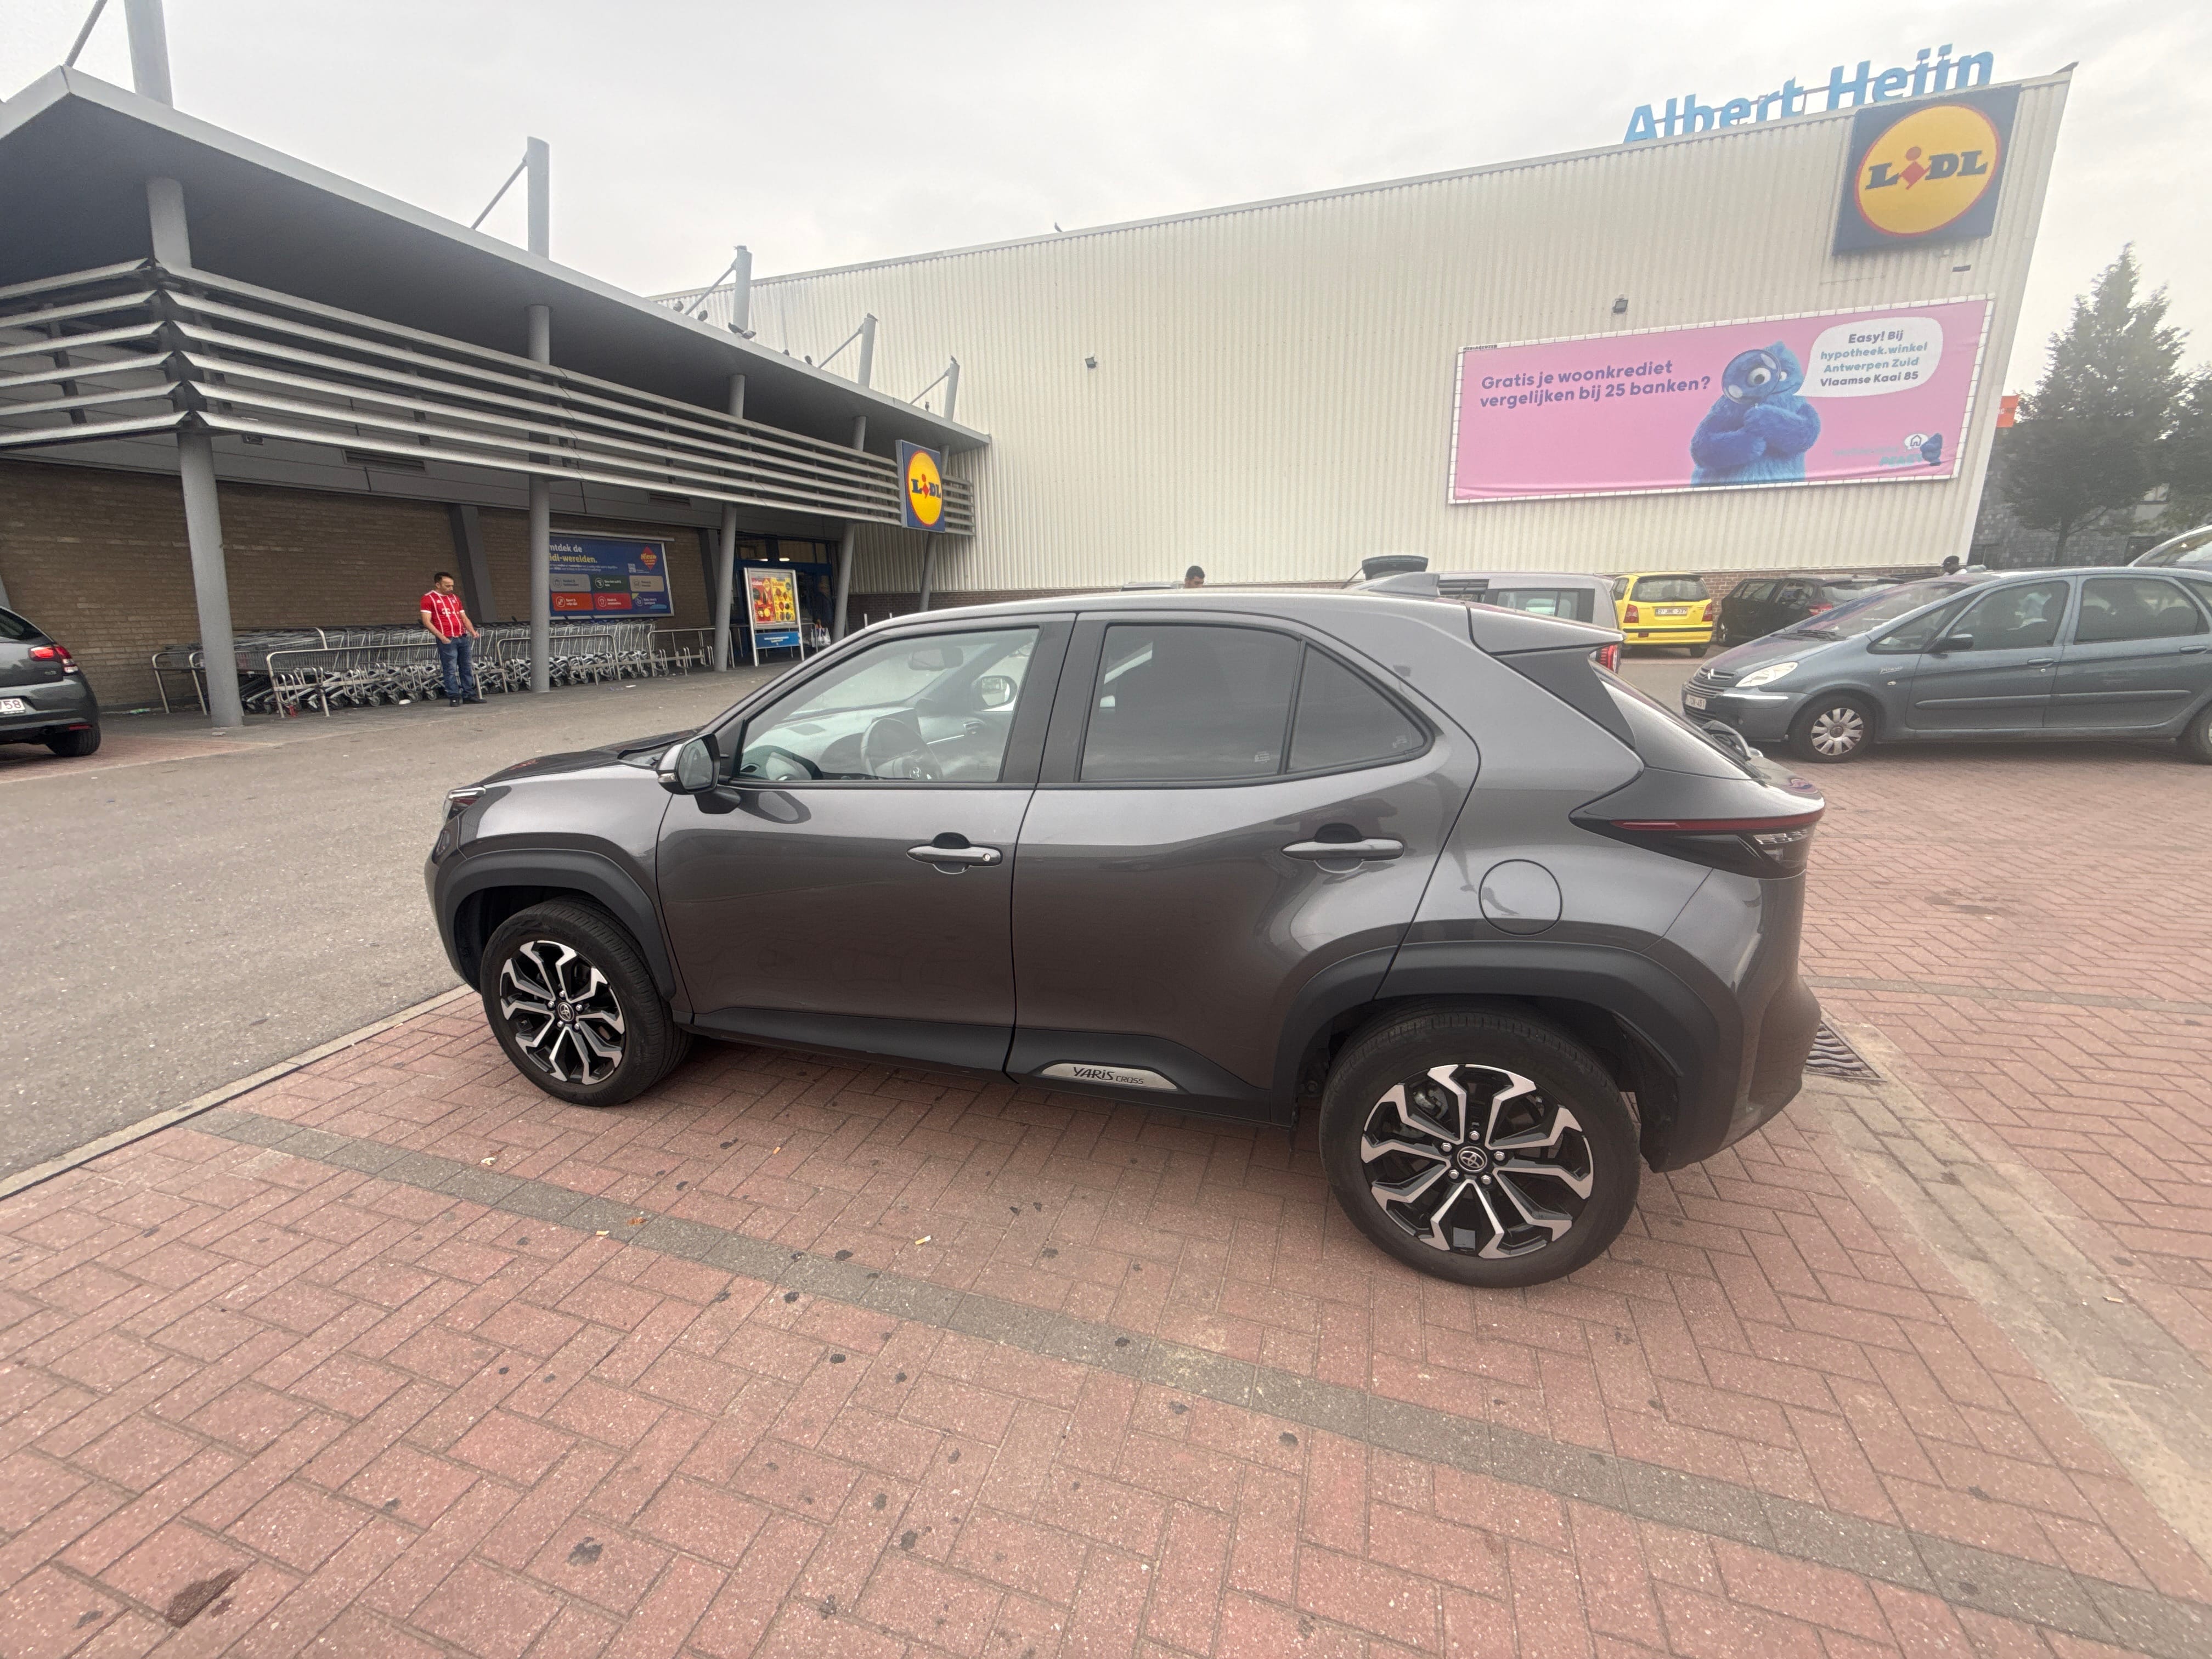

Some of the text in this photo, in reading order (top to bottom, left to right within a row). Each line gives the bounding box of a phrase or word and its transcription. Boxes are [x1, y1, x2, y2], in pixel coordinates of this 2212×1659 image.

[1623, 76, 1804, 144] Albert
[1848, 330, 1904, 344] Easy! Bij
[1820, 342, 1928, 361] hypotheek.winkel
[1824, 357, 1920, 373] Antwerpen Zuid
[1482, 360, 1673, 389] Gratis je woonkrediet
[1820, 371, 1918, 387] Vlaamse Kaai 85
[1480, 376, 1711, 409] vergelijken bij 25 banken?
[549, 544, 582, 552] ntdek de
[1116, 1076, 1144, 1085] CROSS
